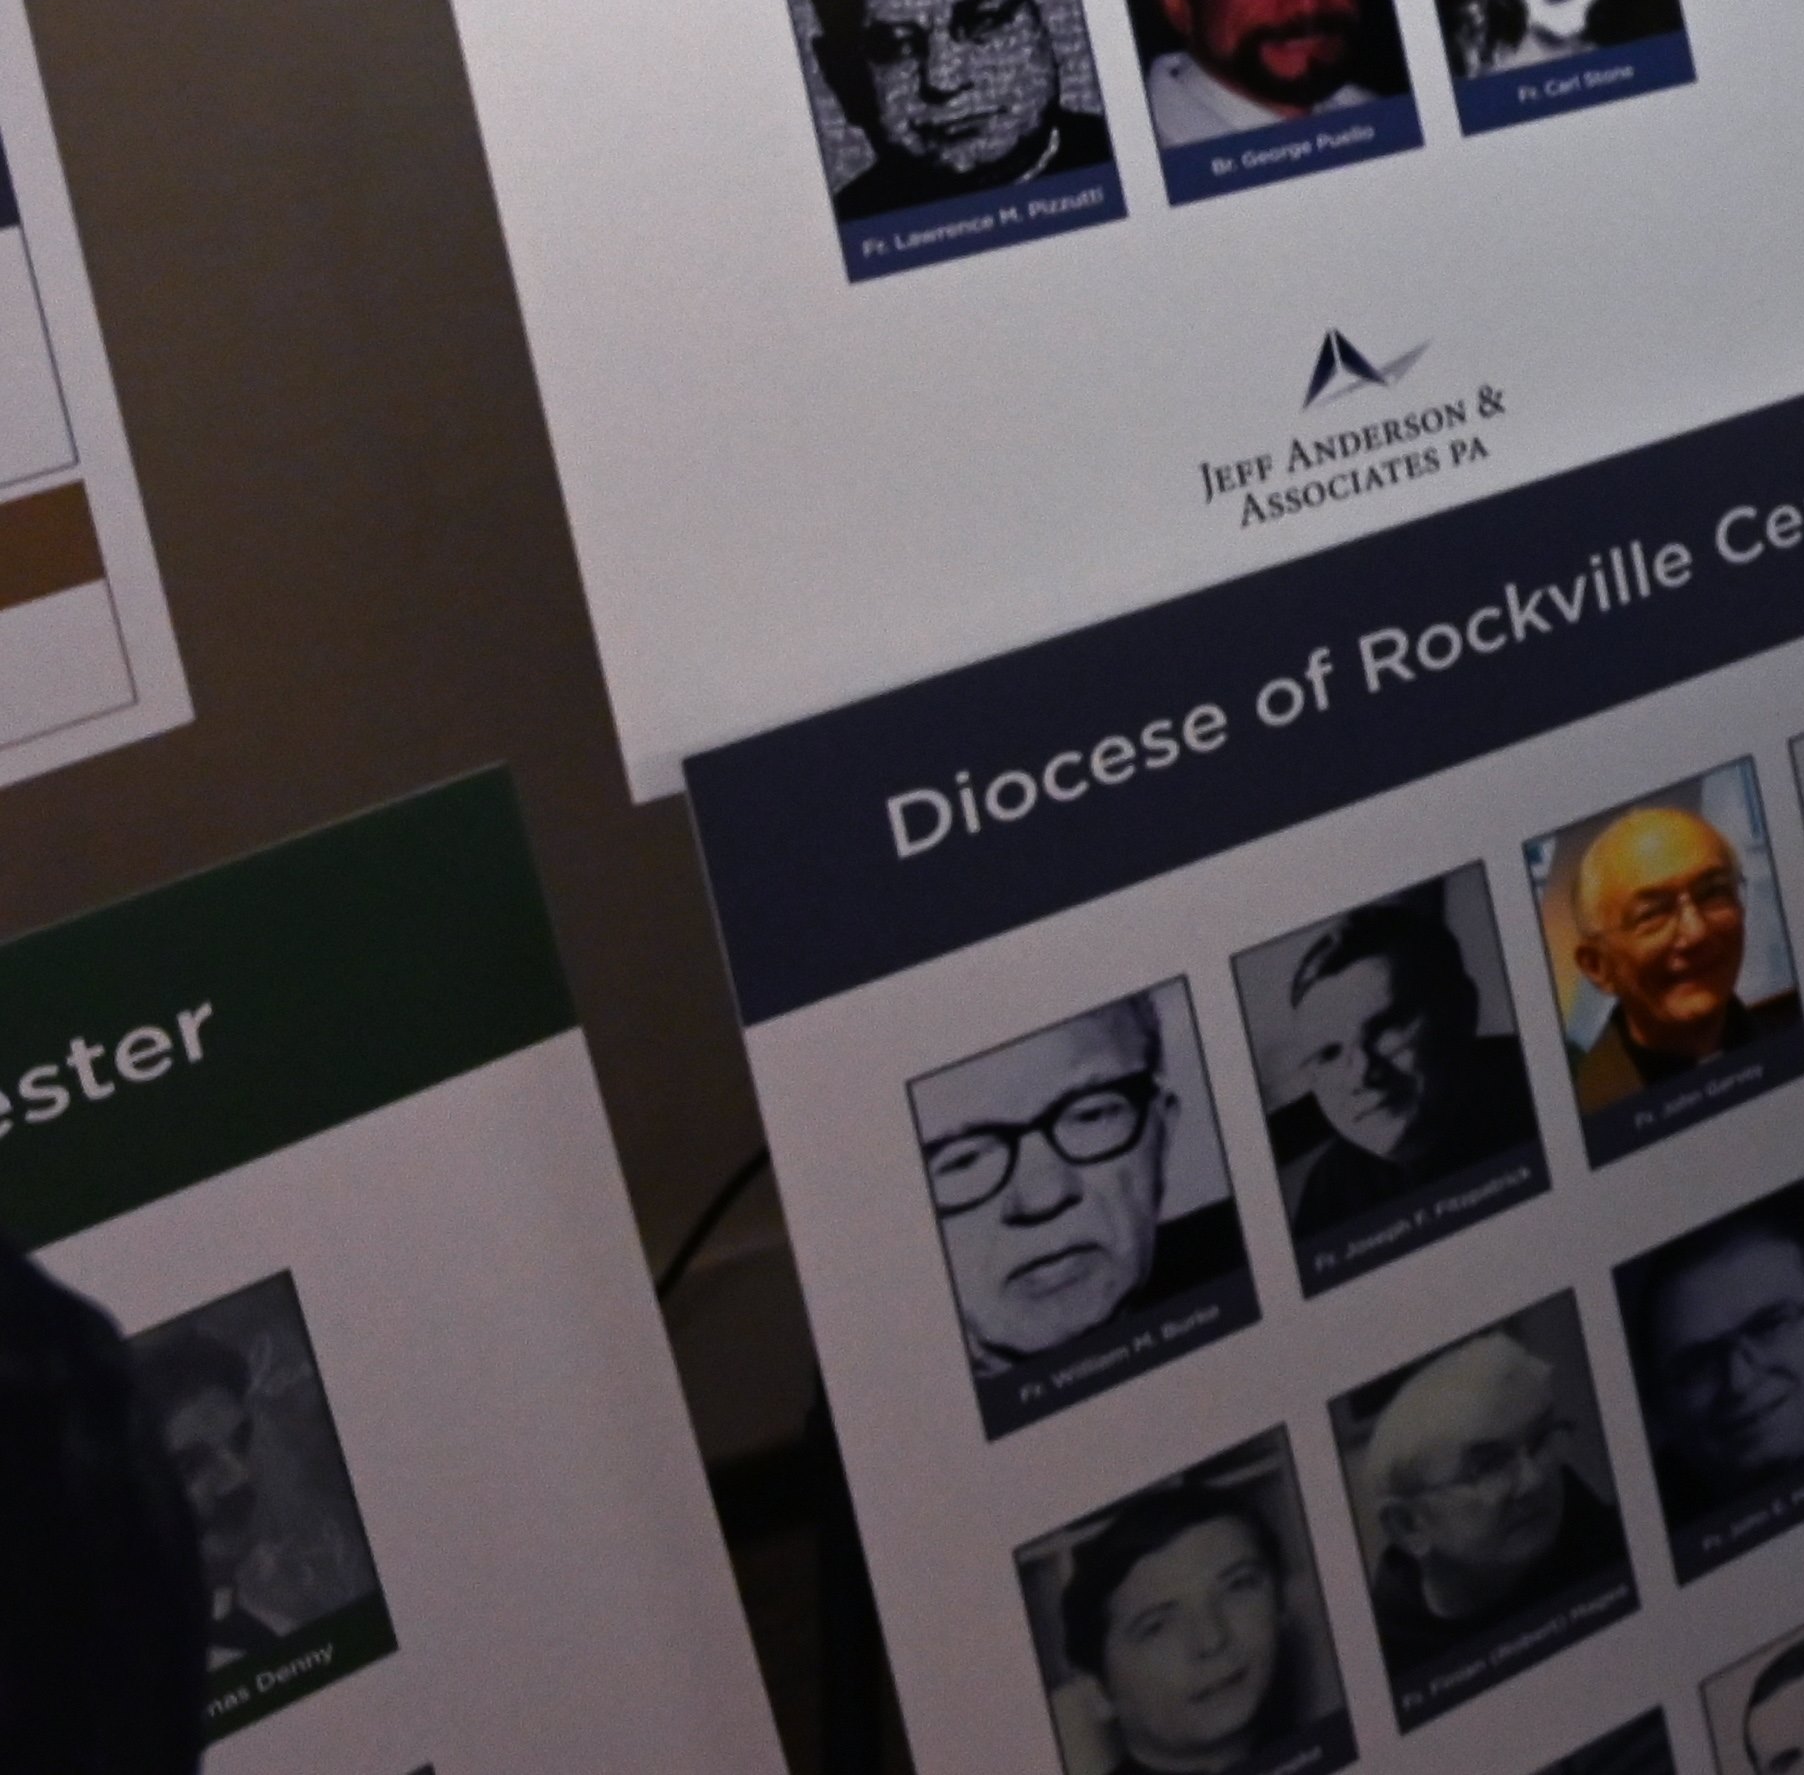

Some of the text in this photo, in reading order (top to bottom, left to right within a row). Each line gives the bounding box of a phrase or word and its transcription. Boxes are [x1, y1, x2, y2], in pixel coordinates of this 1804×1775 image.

[1517, 85, 1539, 103] Fr.
[1543, 74, 1581, 97] Carl
[1210, 157, 1234, 176] Br.
[1240, 140, 1313, 169] George
[861, 238, 888, 258] Fr.
[893, 214, 995, 251] Lawrence
[998, 206, 1020, 225] M.
[1199, 384, 1506, 505] JEFF ANDERSON &
[1240, 436, 1490, 529] ASSOCIATES PA
[884, 703, 1229, 860] Diocese
[1255, 647, 1335, 730] of
[1358, 547, 1693, 694] Rockville
[255, 1640, 334, 1694] Denny
